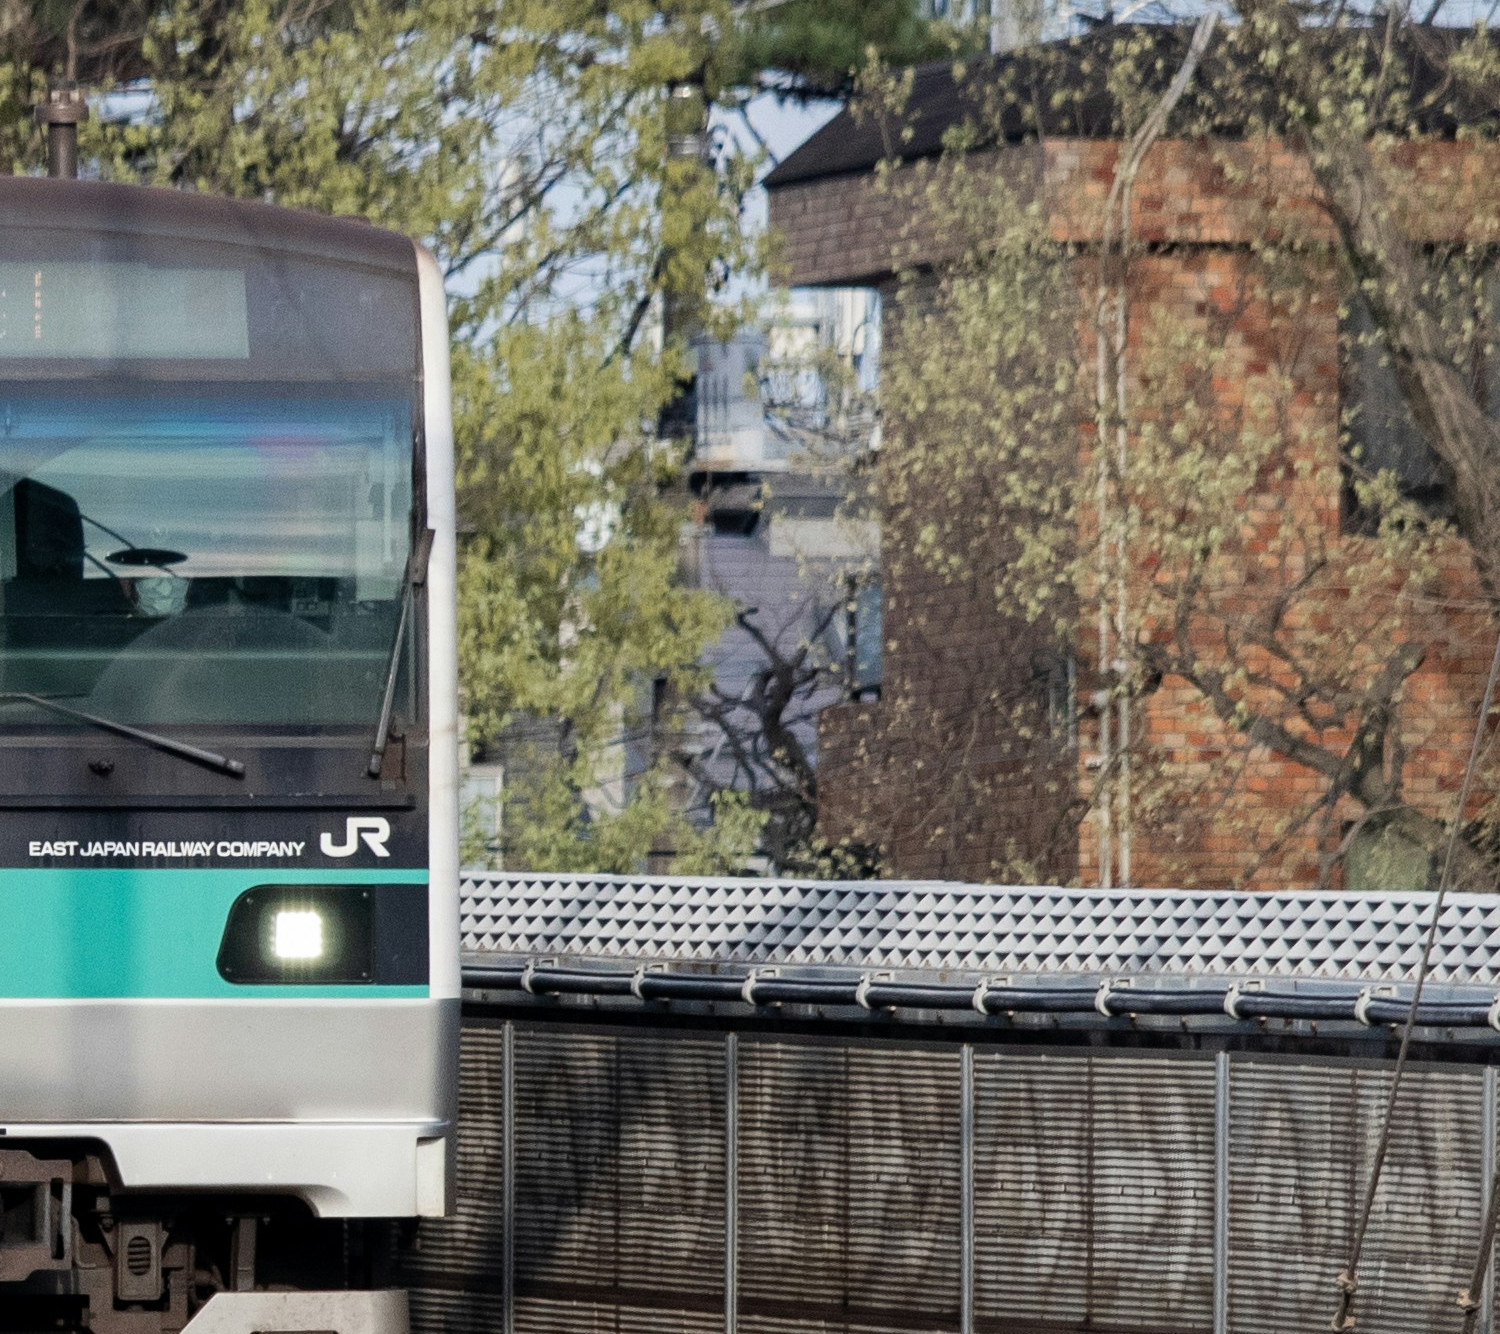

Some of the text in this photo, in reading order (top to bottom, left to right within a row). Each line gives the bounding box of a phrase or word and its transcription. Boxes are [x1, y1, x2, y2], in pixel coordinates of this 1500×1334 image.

[28, 840, 306, 858] EAST JAPAN RAILWAY COMPANY
[320, 816, 391, 858] JR
